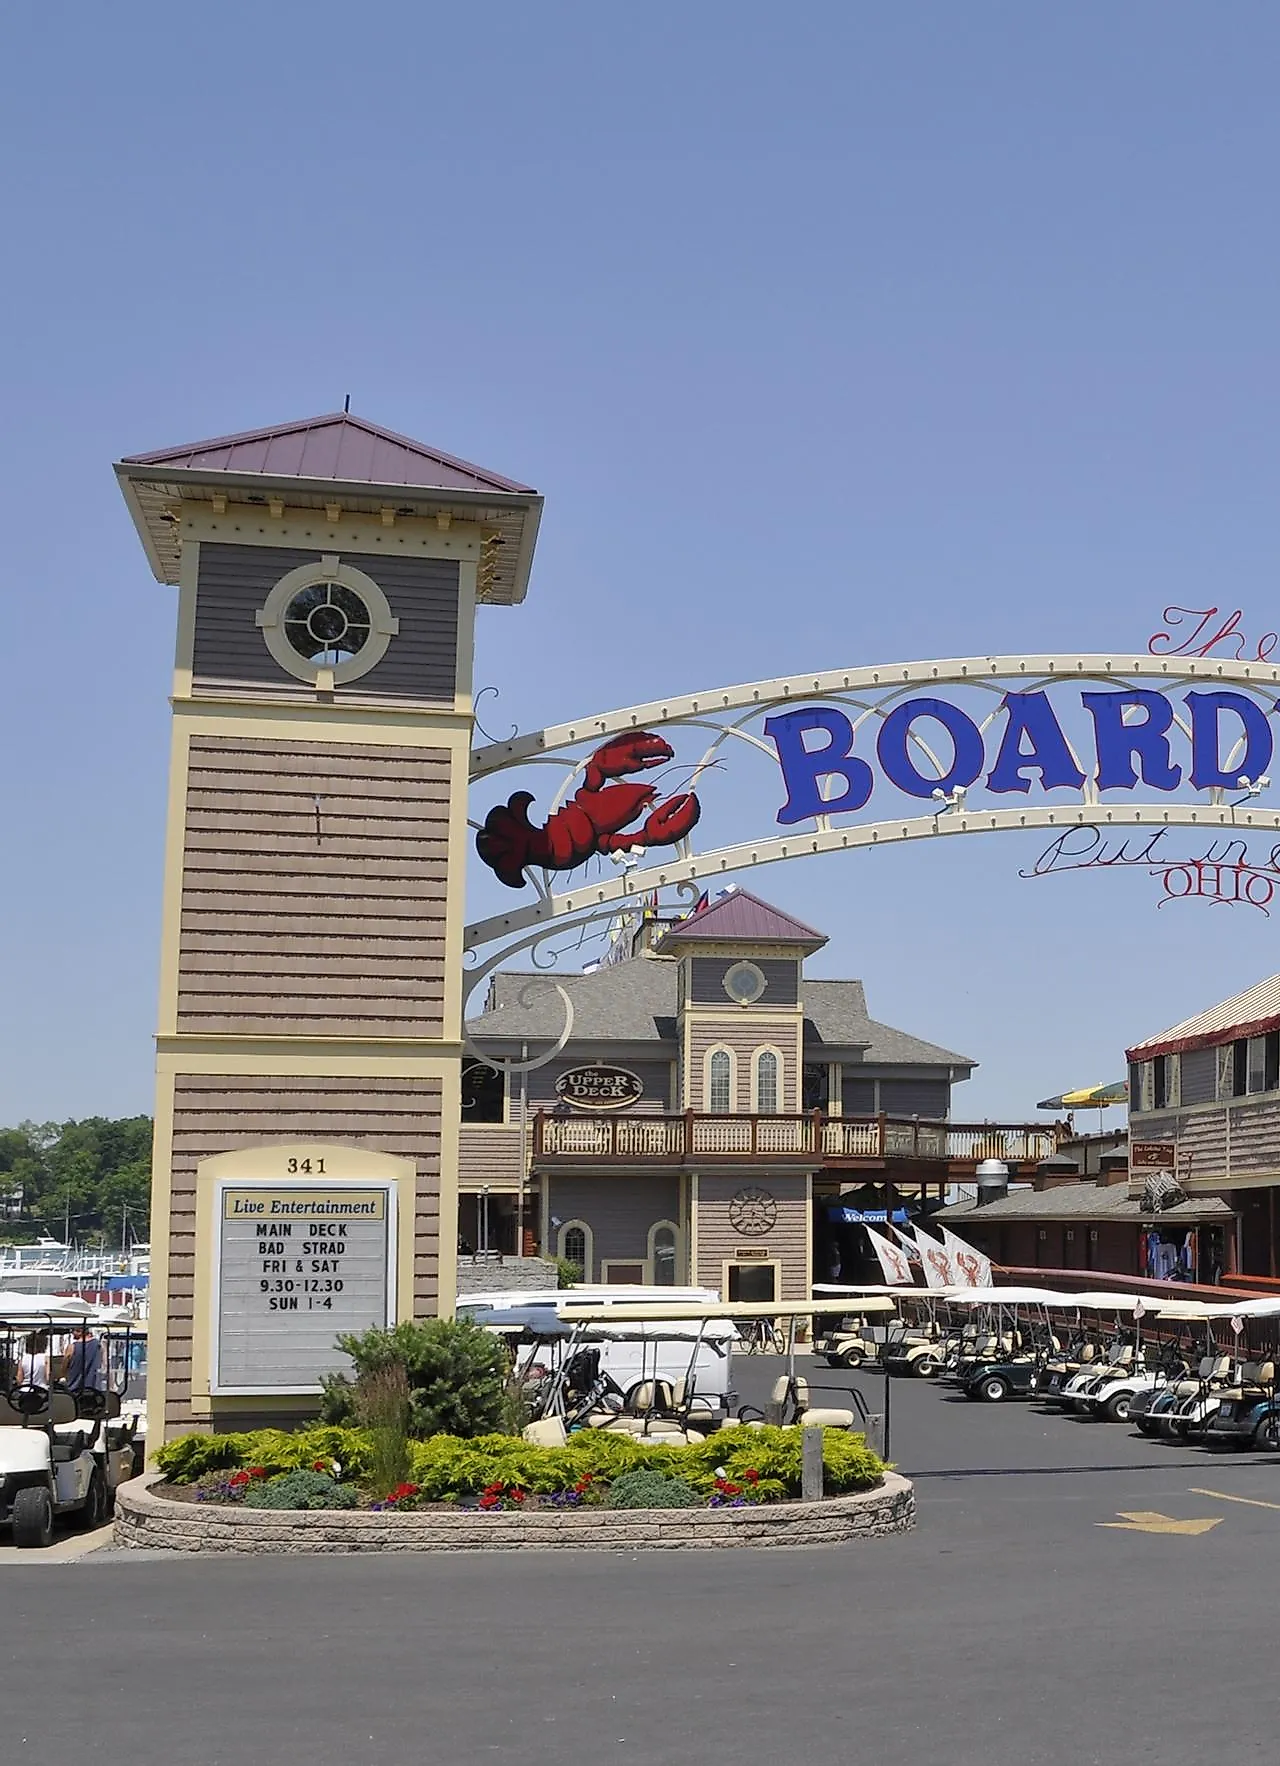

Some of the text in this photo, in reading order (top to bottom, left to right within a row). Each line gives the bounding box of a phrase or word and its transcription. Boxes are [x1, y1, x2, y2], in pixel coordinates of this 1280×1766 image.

[1148, 606, 1279, 663] The
[1034, 824, 1169, 874] Put
[1203, 837, 1251, 867] in
[1163, 864, 1274, 906] OHIO
[568, 1074, 630, 1087] UPPER
[573, 1085, 626, 1097] DECK
[287, 1158, 327, 1174] 341
[234, 1199, 376, 1214] Live Entertainment
[843, 1212, 888, 1222] Welcom
[256, 1224, 348, 1236] MAIN DECK
[259, 1242, 345, 1254] BAD STRAD
[263, 1260, 340, 1272] FRI & SAT
[260, 1280, 344, 1292] 9.30-12.30
[269, 1297, 333, 1310] SUN 1-4
